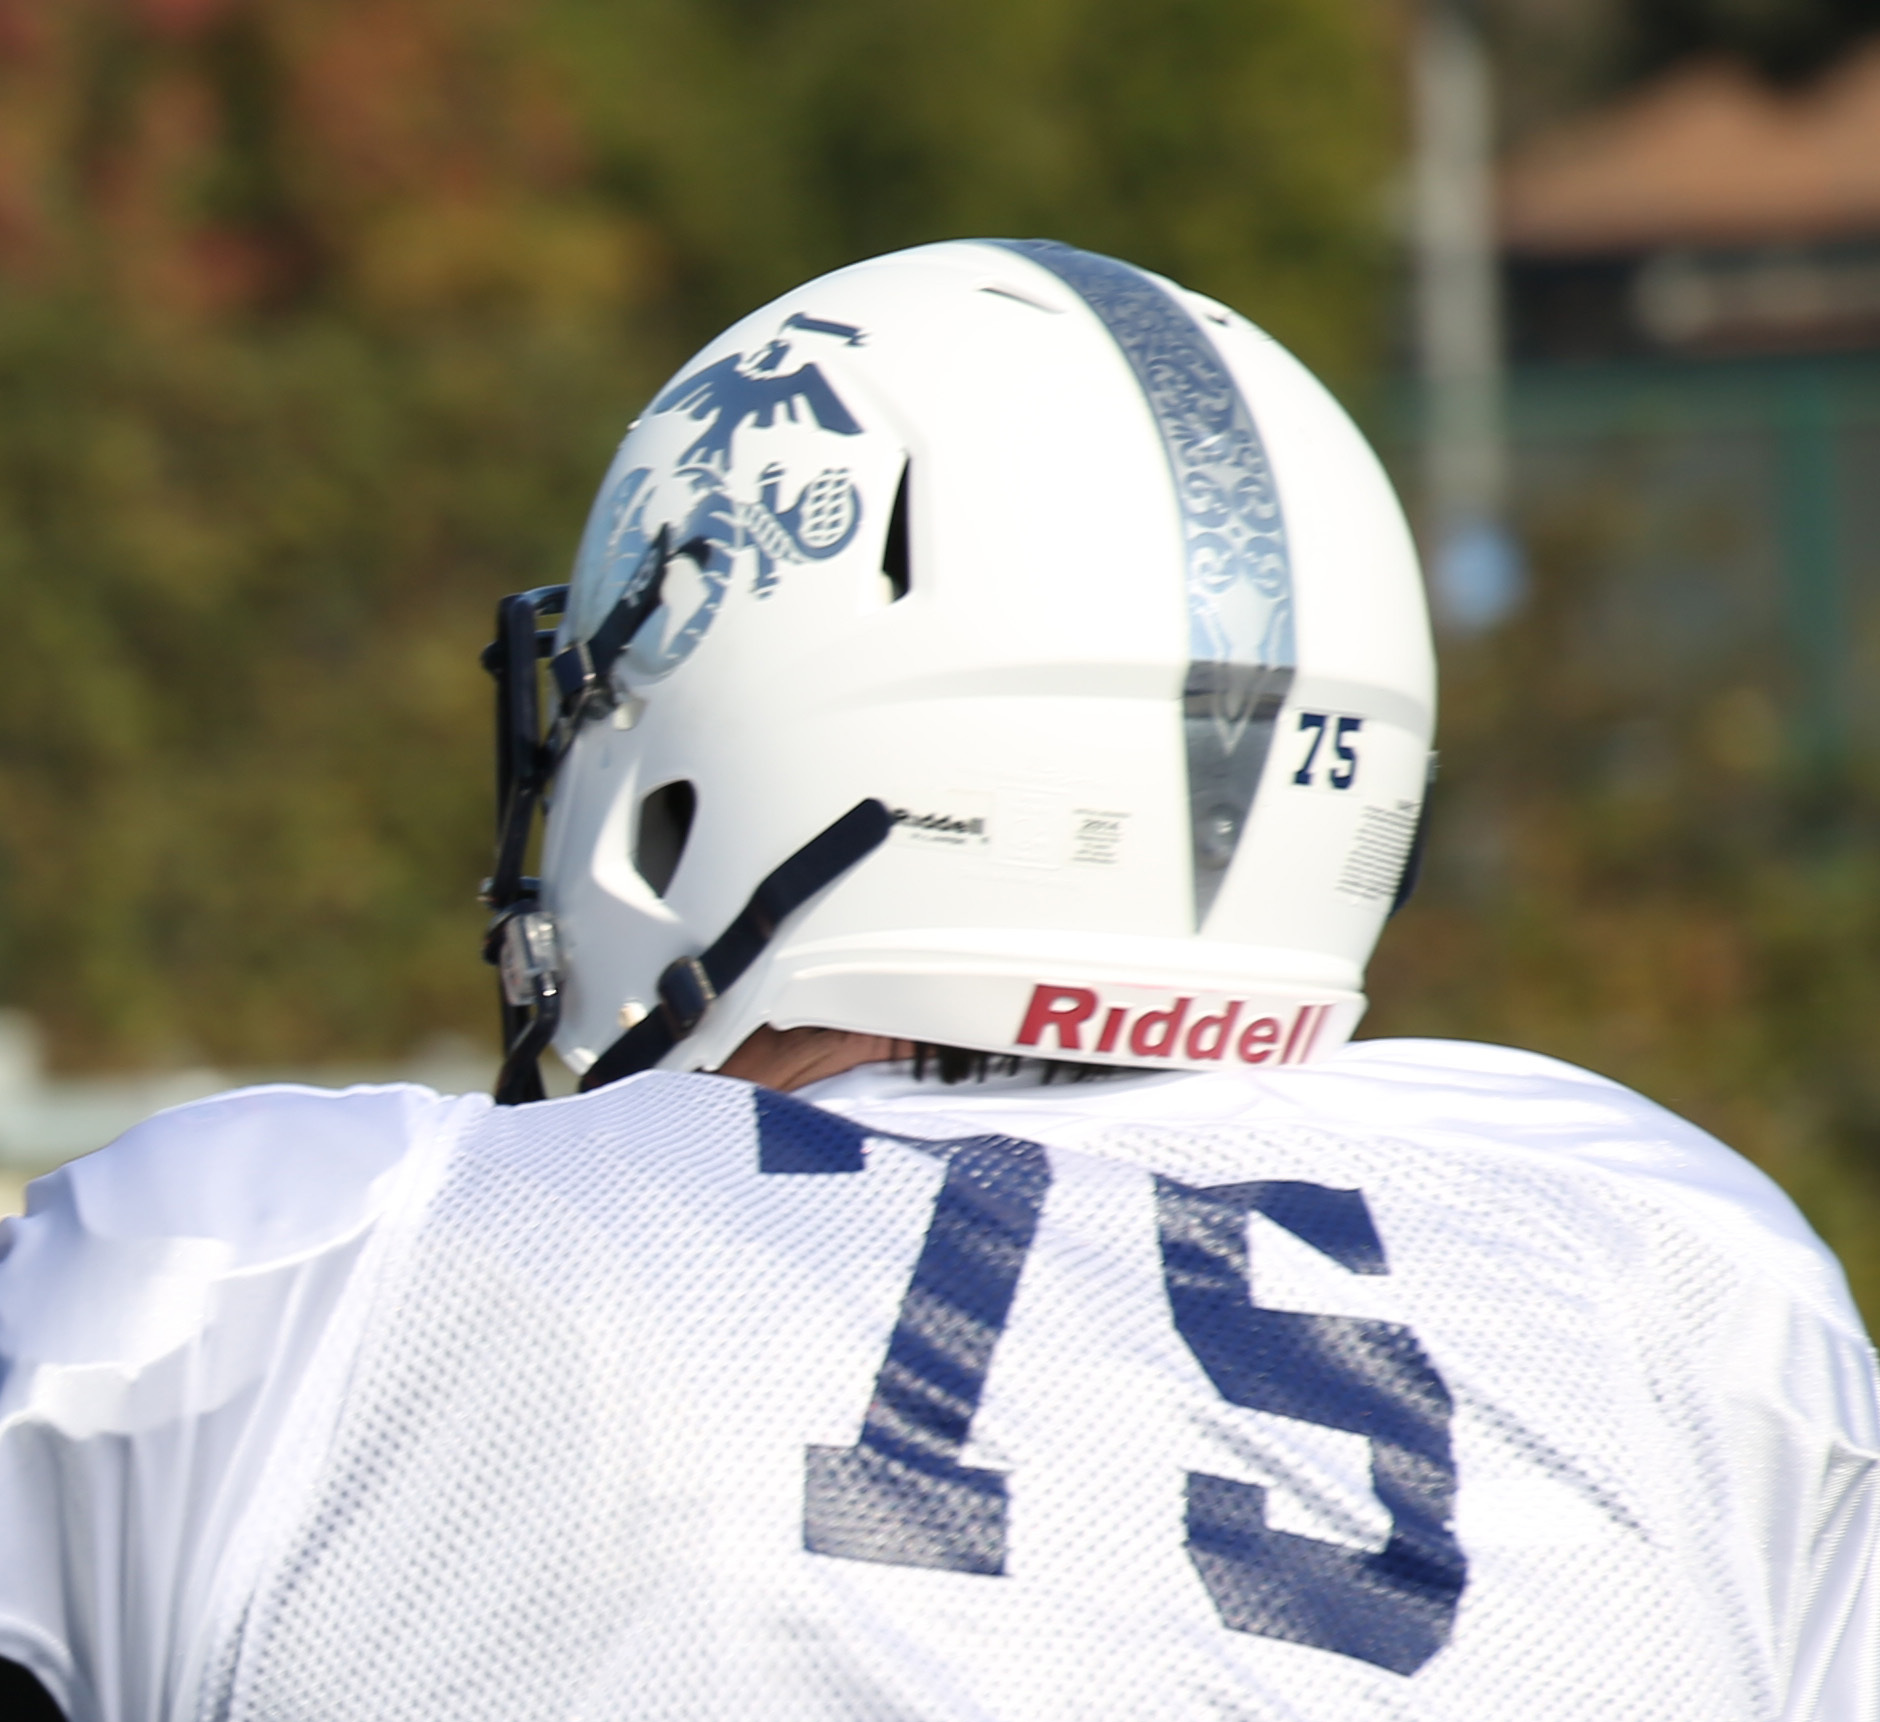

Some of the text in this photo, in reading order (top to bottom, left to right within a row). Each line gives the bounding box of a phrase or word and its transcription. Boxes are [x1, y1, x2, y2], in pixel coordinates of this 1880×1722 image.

[1292, 712, 1365, 790] 75
[1014, 982, 1336, 1064] Riddell
[754, 1084, 1470, 1679] 75
